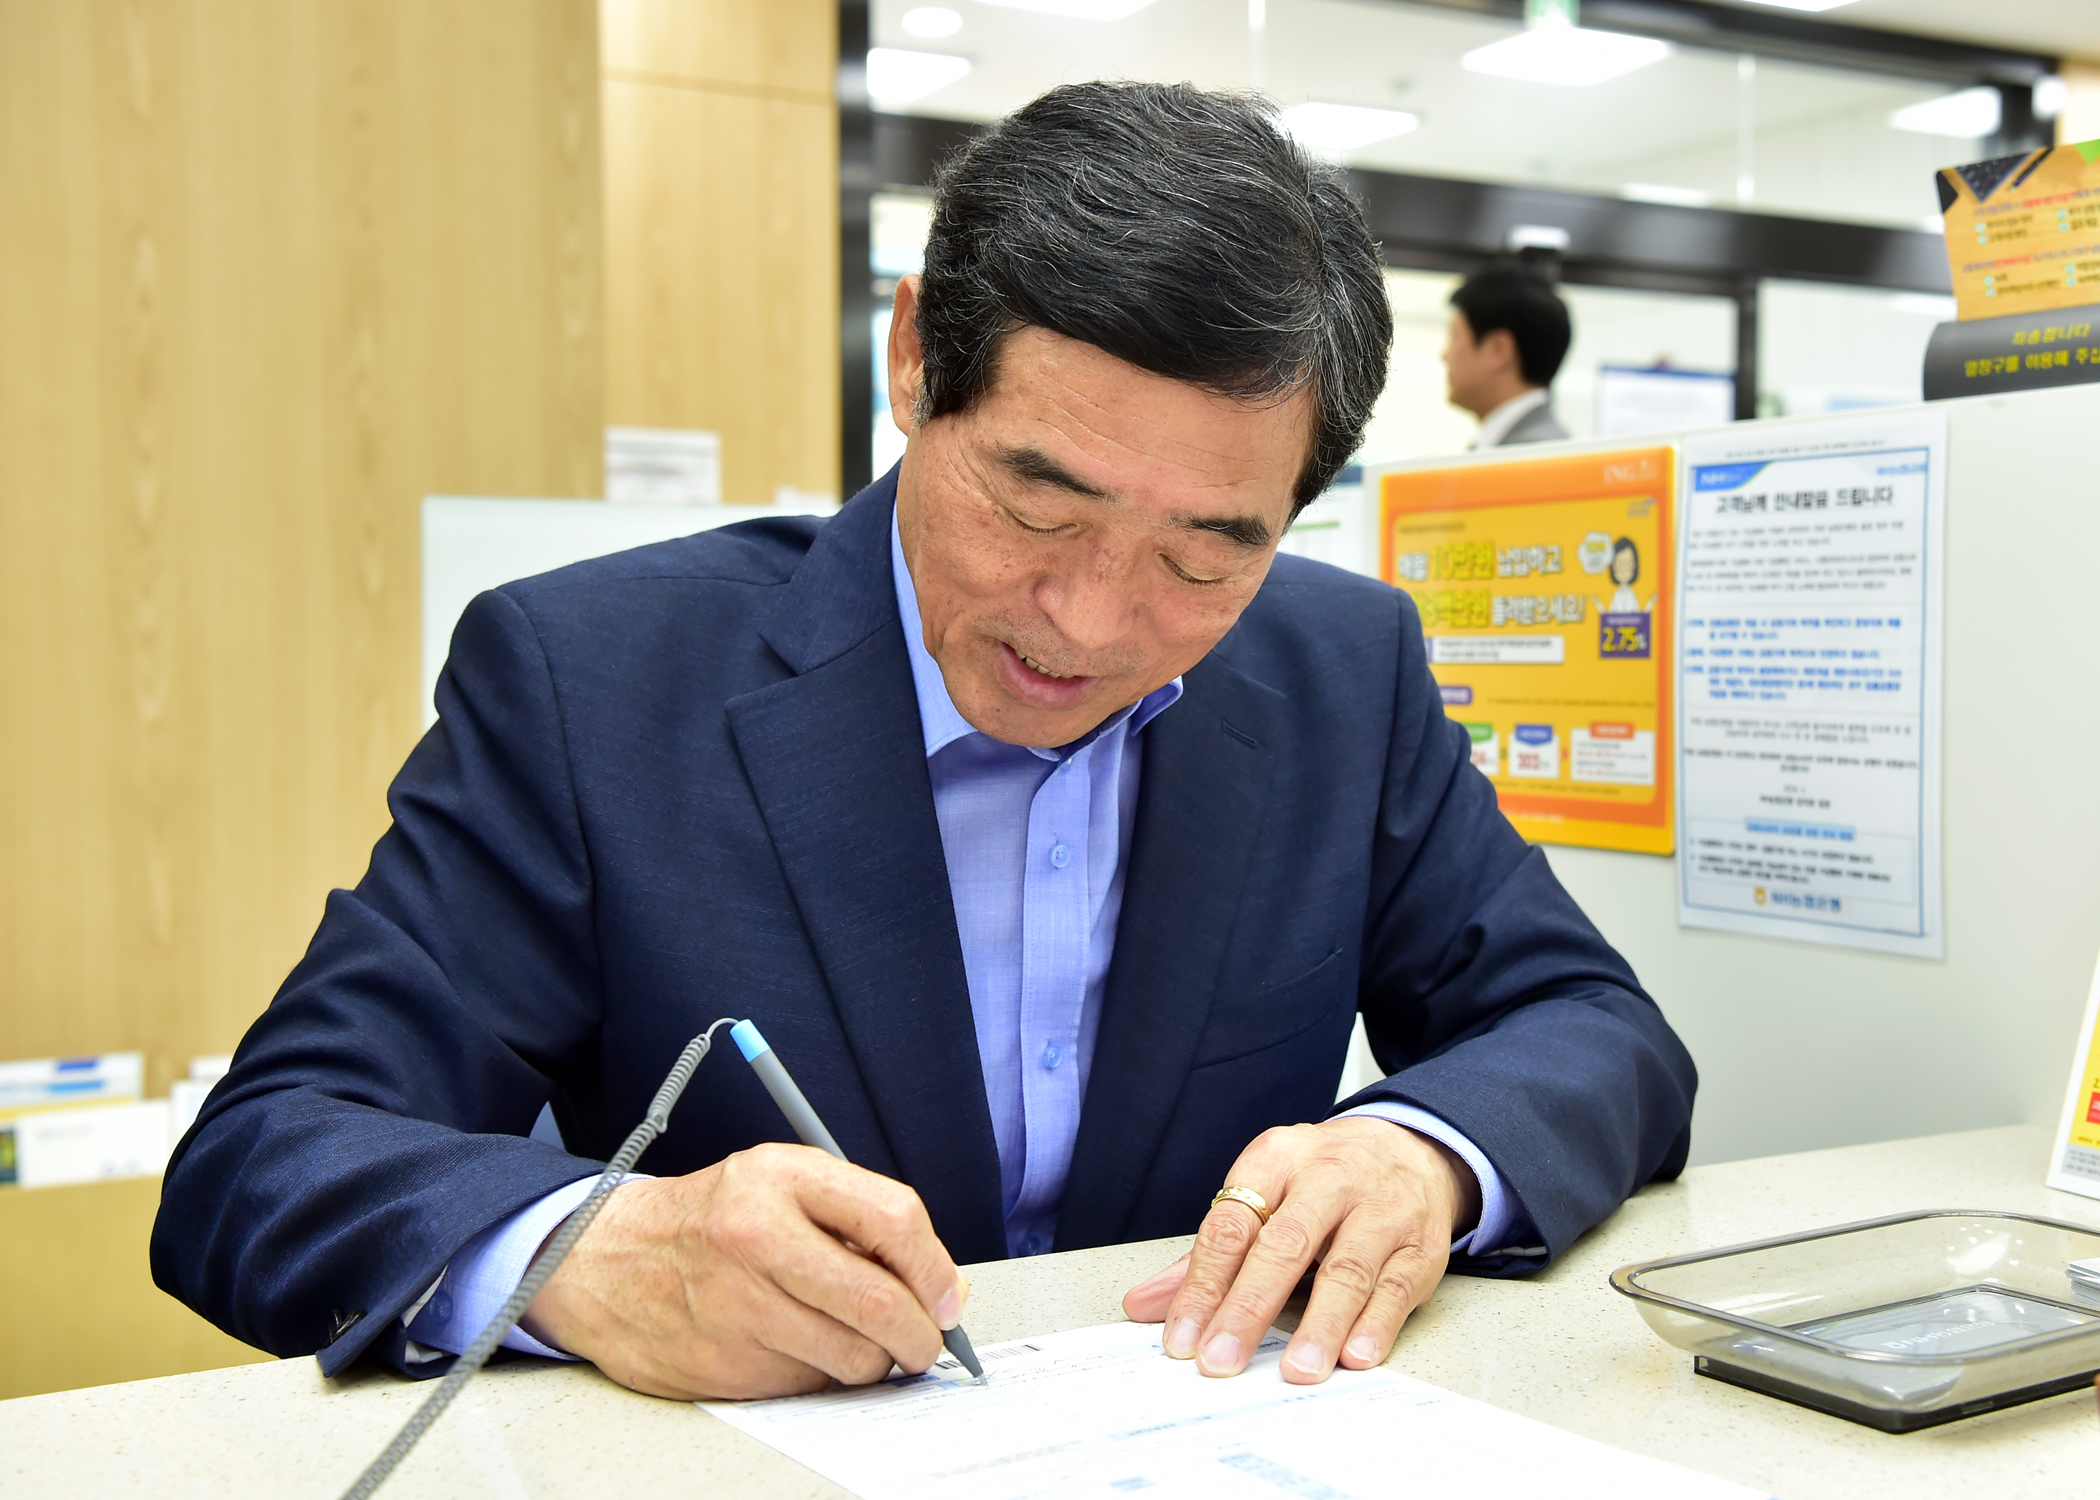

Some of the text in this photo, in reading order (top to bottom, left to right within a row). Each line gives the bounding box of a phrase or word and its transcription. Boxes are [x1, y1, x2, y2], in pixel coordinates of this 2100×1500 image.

[2011, 322, 2091, 346] 죄송합니다
[2025, 349, 2069, 370] 이용해
[1716, 492, 1767, 513] 고객님께
[1835, 486, 1893, 507] 드립니다
[1431, 541, 1495, 580] 10만원
[1497, 545, 1563, 577] 납입하고
